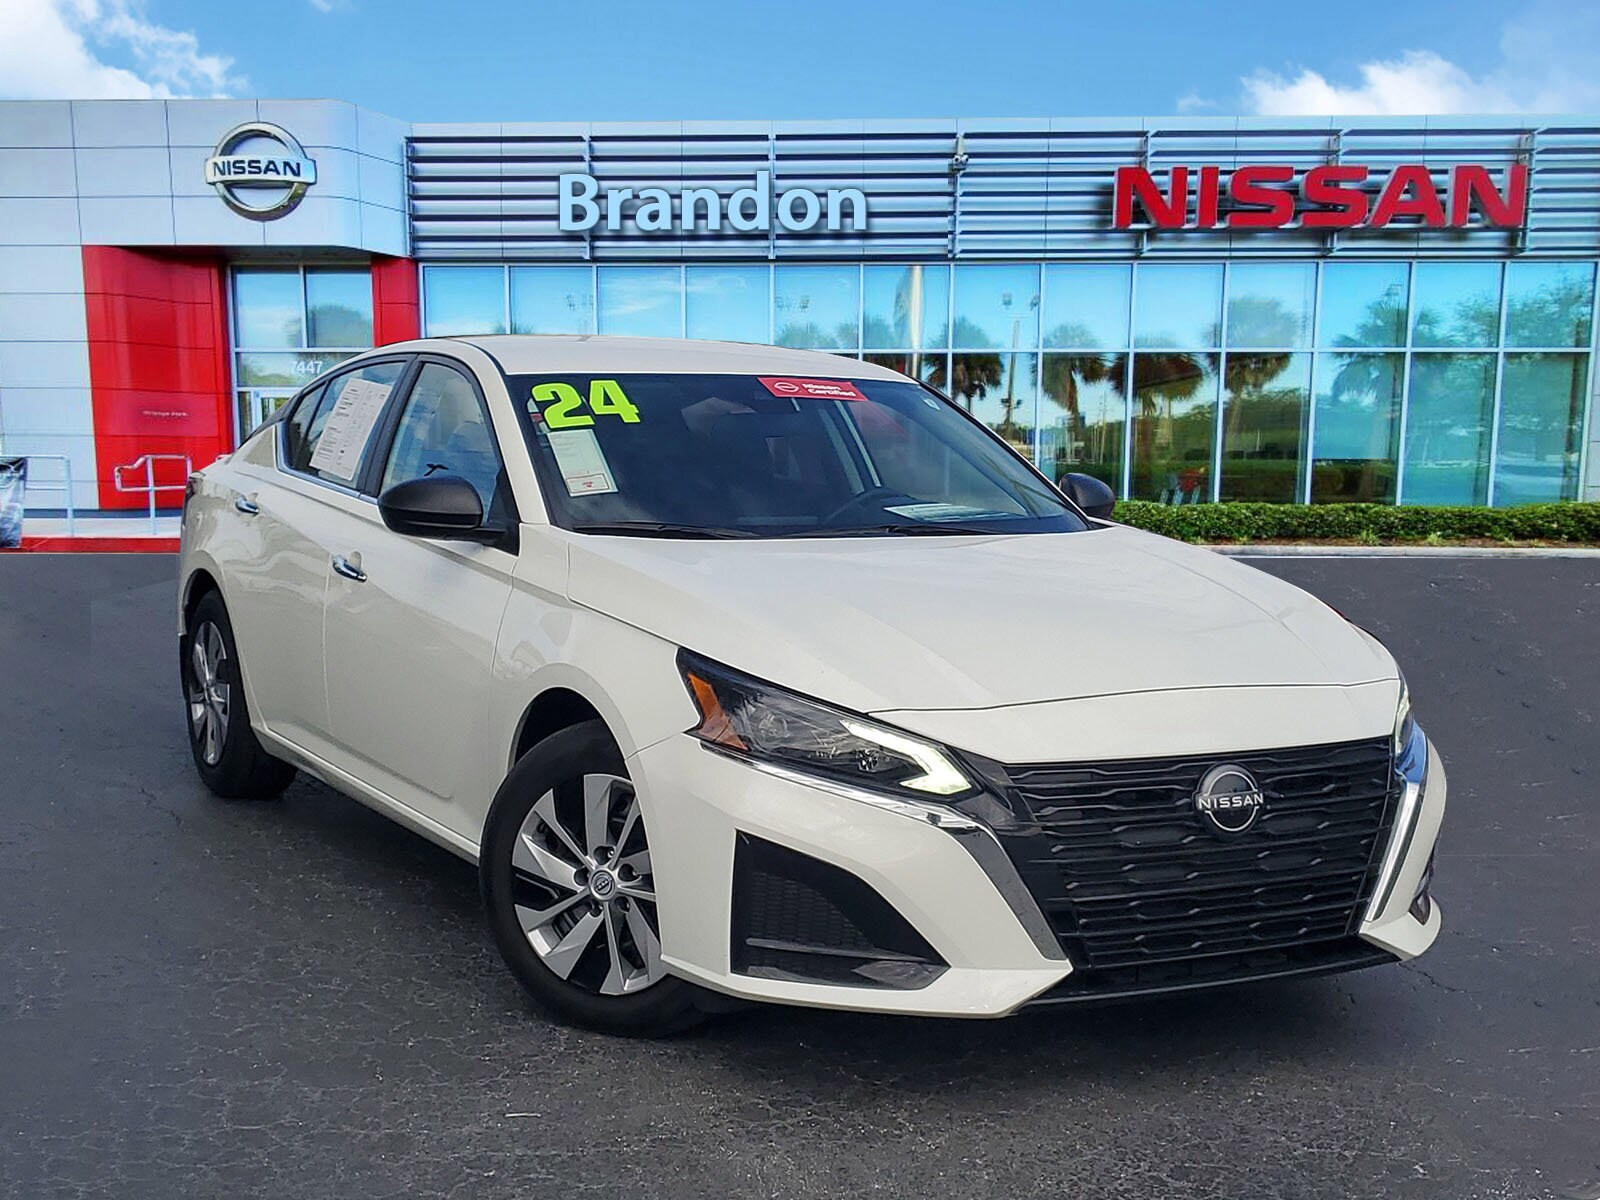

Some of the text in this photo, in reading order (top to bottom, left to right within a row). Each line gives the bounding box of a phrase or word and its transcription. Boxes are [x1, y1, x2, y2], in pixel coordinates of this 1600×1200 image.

[213, 160, 301, 177] NISSAN
[559, 170, 867, 231] Brandon
[1112, 164, 1528, 229] NISSAN
[292, 360, 323, 374] 7447
[807, 388, 857, 397] Certified
[531, 380, 640, 429] 24
[1198, 793, 1264, 810] NISSAN
